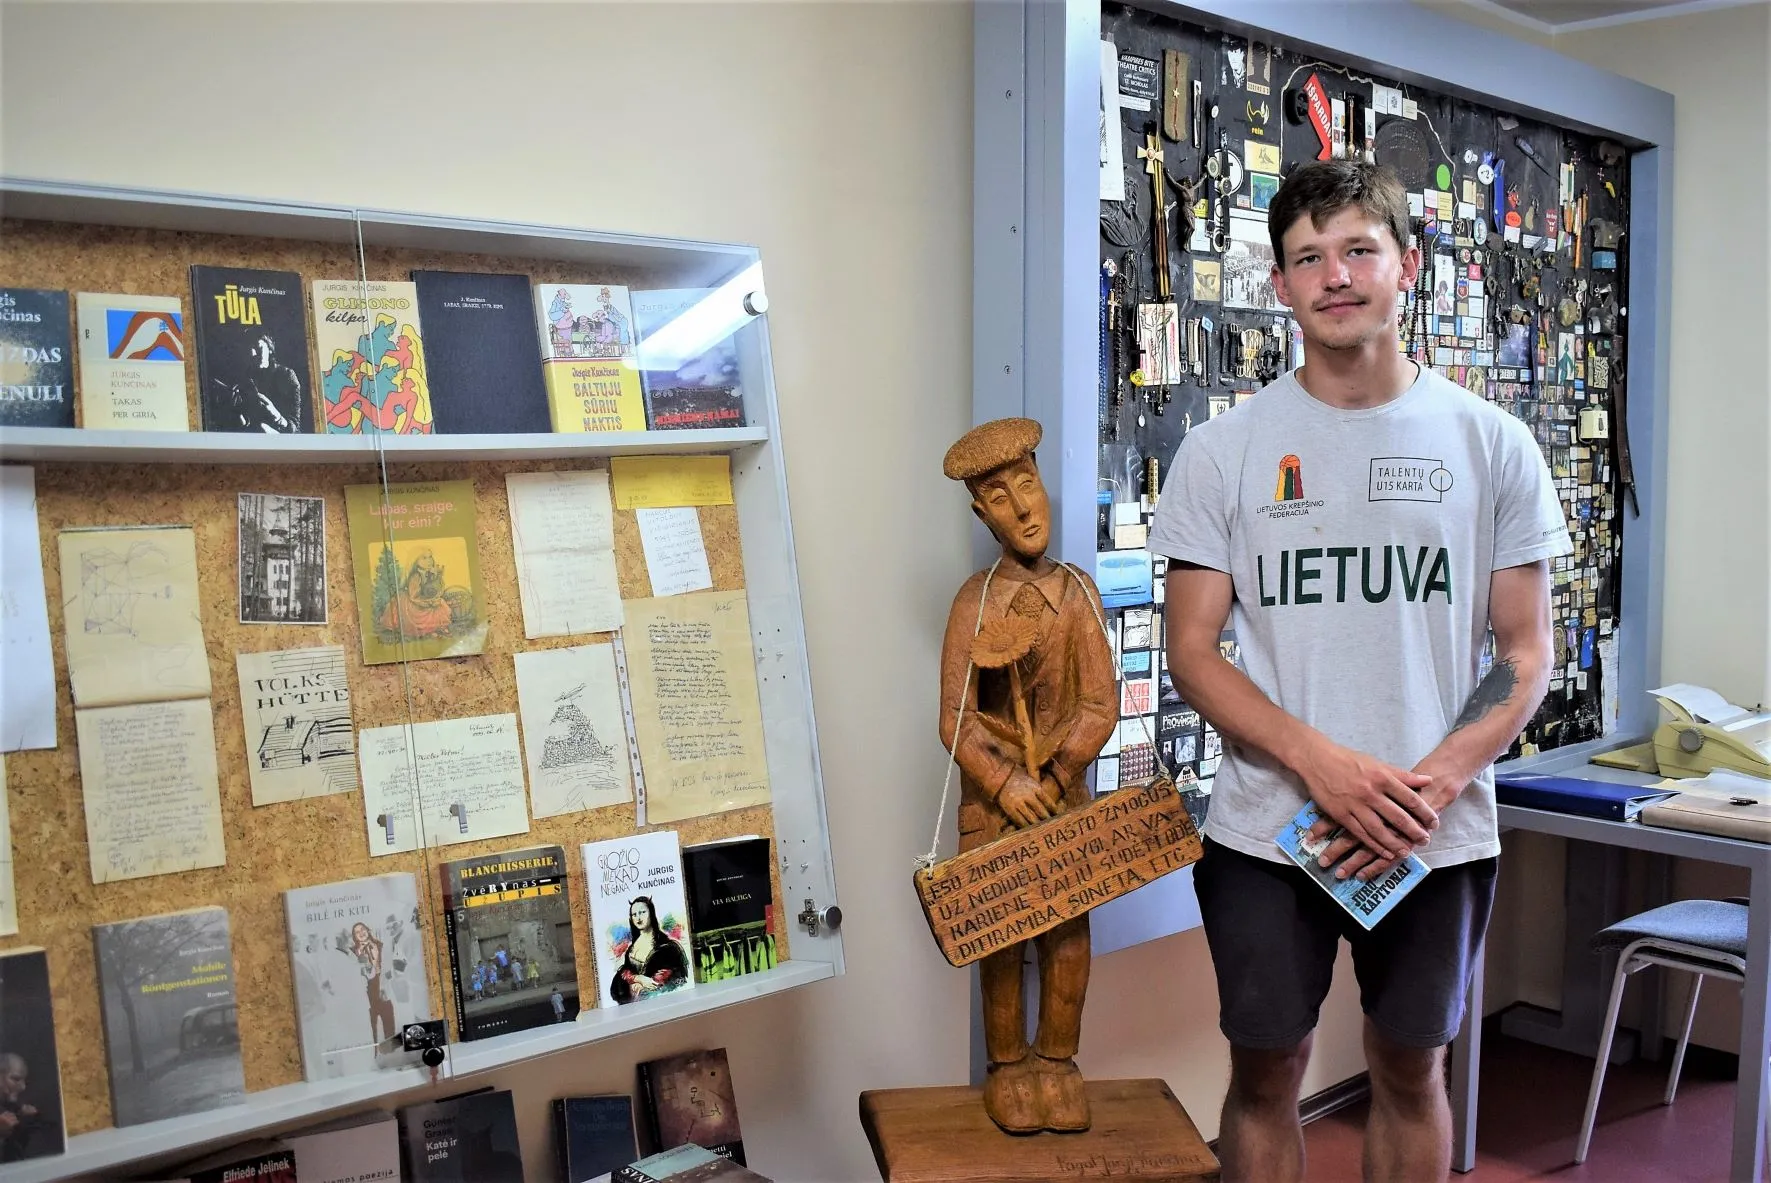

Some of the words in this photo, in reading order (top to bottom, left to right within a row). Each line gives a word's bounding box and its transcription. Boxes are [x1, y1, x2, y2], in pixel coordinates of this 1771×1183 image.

[323, 284, 348, 292] JURGIS
[214, 284, 262, 325] TŪLA
[323, 297, 410, 309] GLISONO
[326, 310, 368, 325] kilpa
[111, 371, 141, 379] JURGIS
[574, 382, 622, 397] BALTŲJŲ
[113, 398, 141, 406] TAKAS
[583, 398, 618, 414] SŪRIŲ
[583, 415, 622, 431] NAKTIS
[1378, 467, 1425, 481] TALENTŲ
[1376, 481, 1394, 491] U15
[1396, 481, 1424, 491] KARTA
[1256, 503, 1288, 514] LIETUVOS
[1289, 500, 1325, 510] KREPŠINIO
[1269, 509, 1310, 519] FEDERACIJA
[1257, 545, 1453, 607] LIETUVA
[968, 840, 1041, 884] ŽINOMAS
[1043, 814, 1097, 851] RAŠTO
[1098, 781, 1172, 822] ŽMOGUS
[597, 848, 640, 870] GROŽIO
[603, 866, 639, 883] NIEKAD
[647, 864, 675, 877] JURGIS
[939, 897, 965, 921] UŽ
[1111, 823, 1138, 846] AR
[637, 876, 676, 890] KUNČINAS
[1040, 863, 1093, 901] GALIU
[1359, 862, 1412, 917] KAPITONAI
[334, 909, 345, 919] IR
[349, 905, 370, 916] KITI
[426, 1138, 449, 1151] Katė
[450, 1137, 458, 1147] ir
[428, 1150, 449, 1164] pelė
[223, 1164, 256, 1183] Elfriede
[257, 1157, 290, 1176] Jelinek
